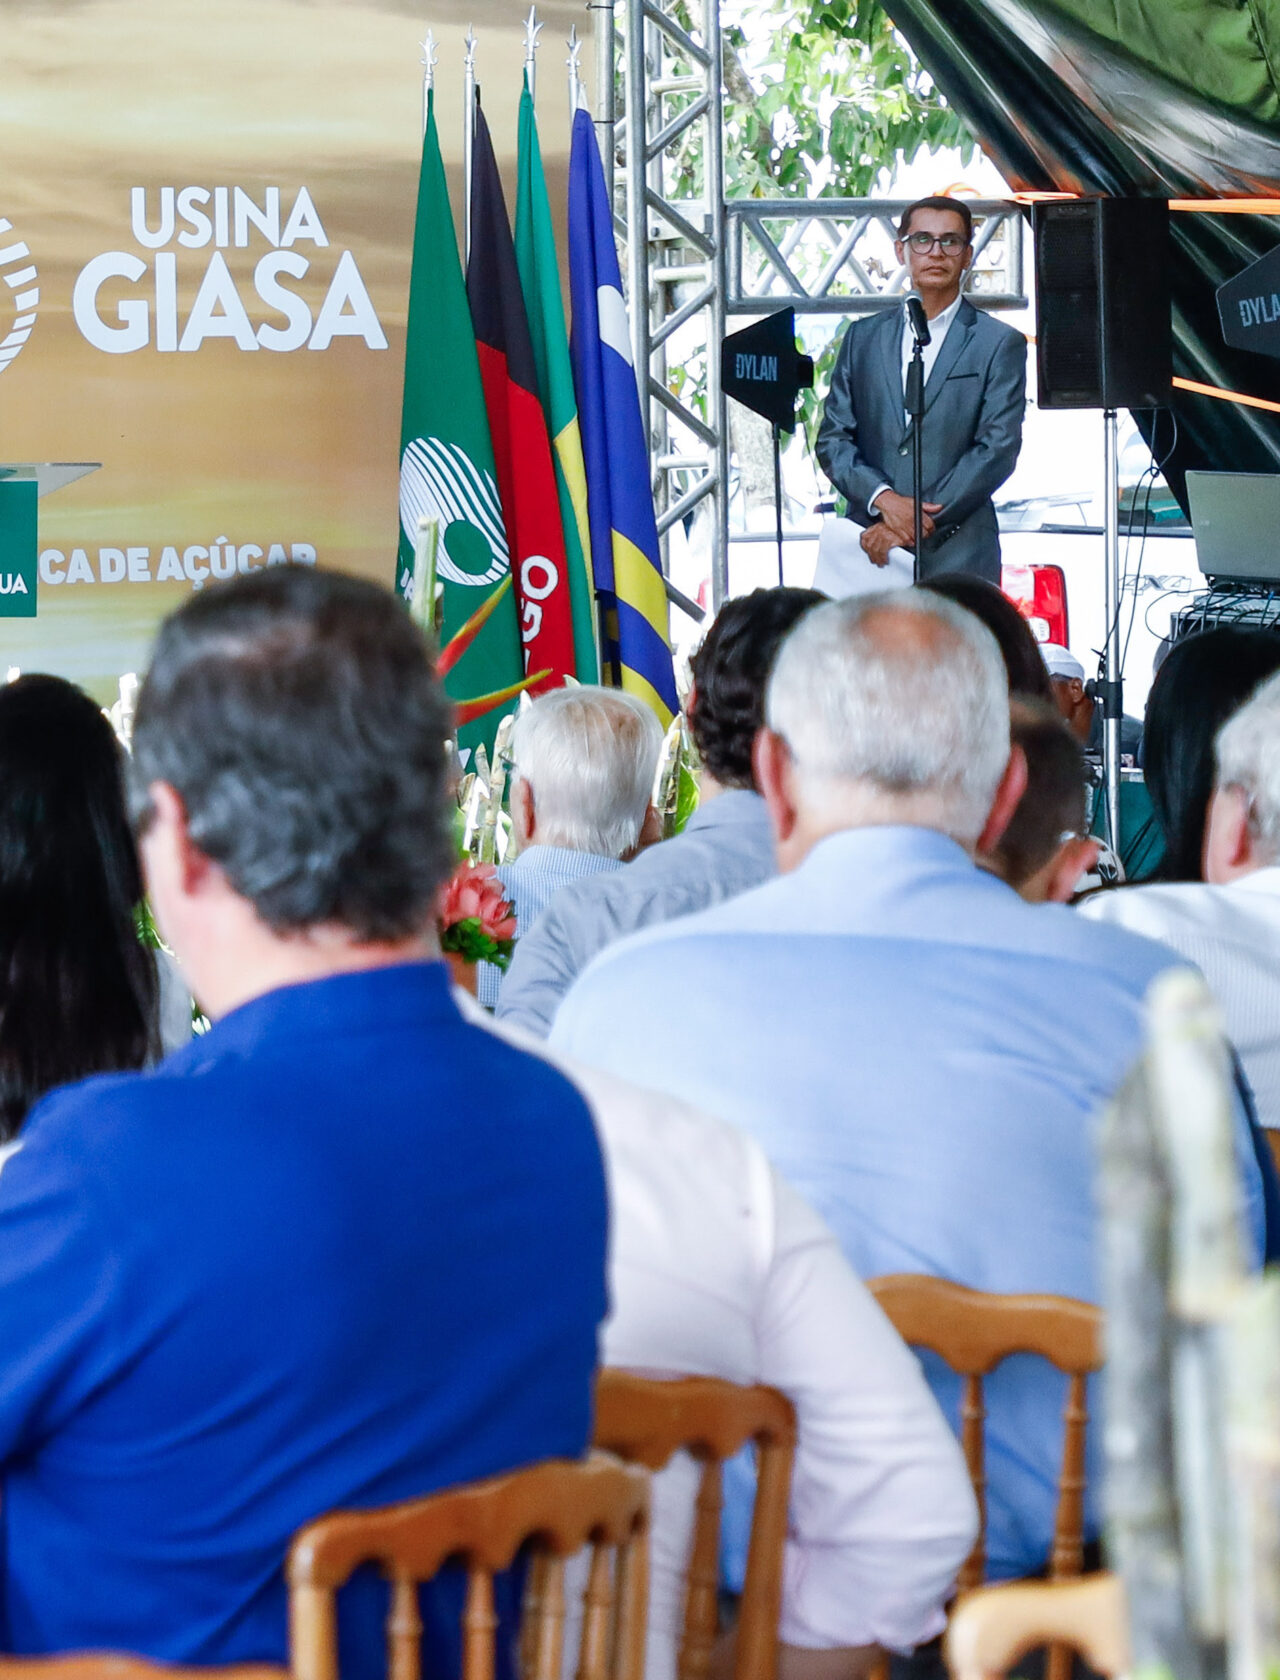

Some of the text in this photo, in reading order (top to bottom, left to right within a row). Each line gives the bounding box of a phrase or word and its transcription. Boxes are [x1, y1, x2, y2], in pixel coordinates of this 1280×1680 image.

[130, 185, 330, 248] USINA
[72, 250, 389, 354] GIASA
[1239, 293, 1280, 328] DYLA
[736, 353, 778, 381] DYLAN
[99, 547, 152, 583] DE
